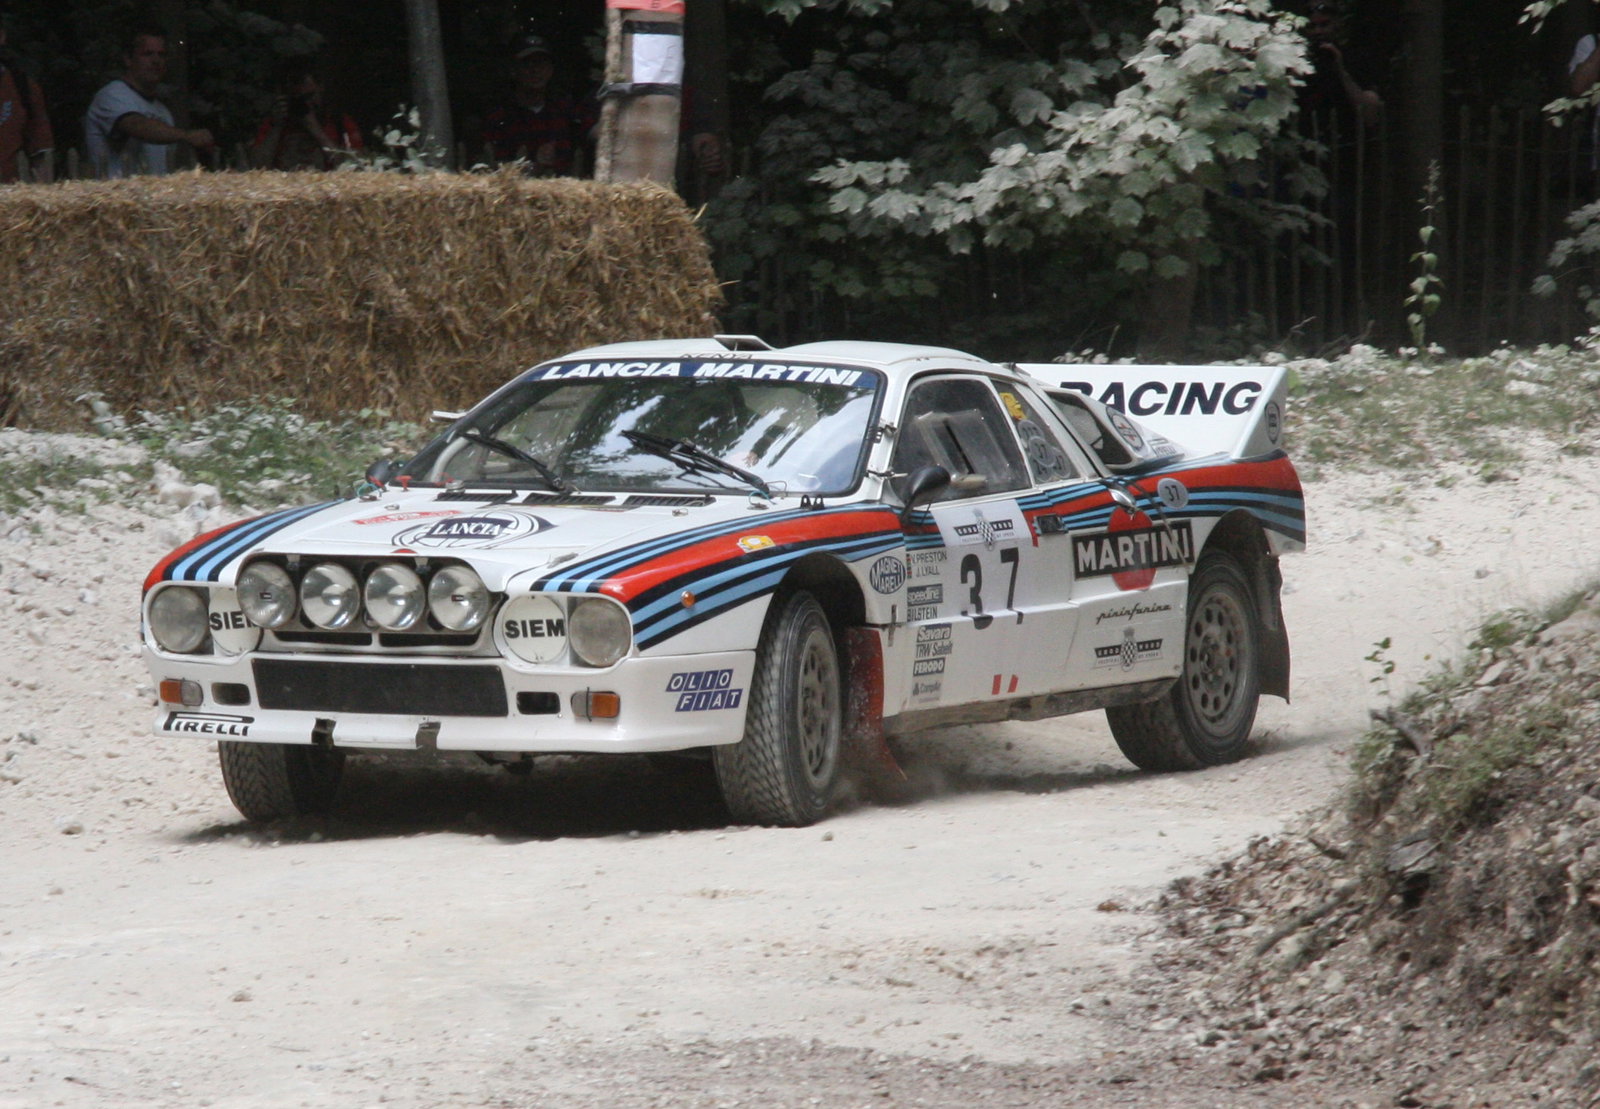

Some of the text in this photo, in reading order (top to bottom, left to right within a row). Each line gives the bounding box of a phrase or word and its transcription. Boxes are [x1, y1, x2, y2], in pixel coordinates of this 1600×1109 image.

[541, 361, 863, 386] LANCIA MARTINI
[1164, 485, 1181, 502] 37
[432, 522, 502, 536] LANCIA
[1077, 527, 1190, 573] MARTINI
[210, 610, 252, 630] SIE
[1096, 603, 1172, 624] pininfarina
[505, 618, 566, 639] SIEM
[914, 659, 944, 674] FERODO
[671, 672, 729, 690] OLIO
[680, 691, 739, 709] FIAT
[163, 711, 254, 737] PIRELLI
